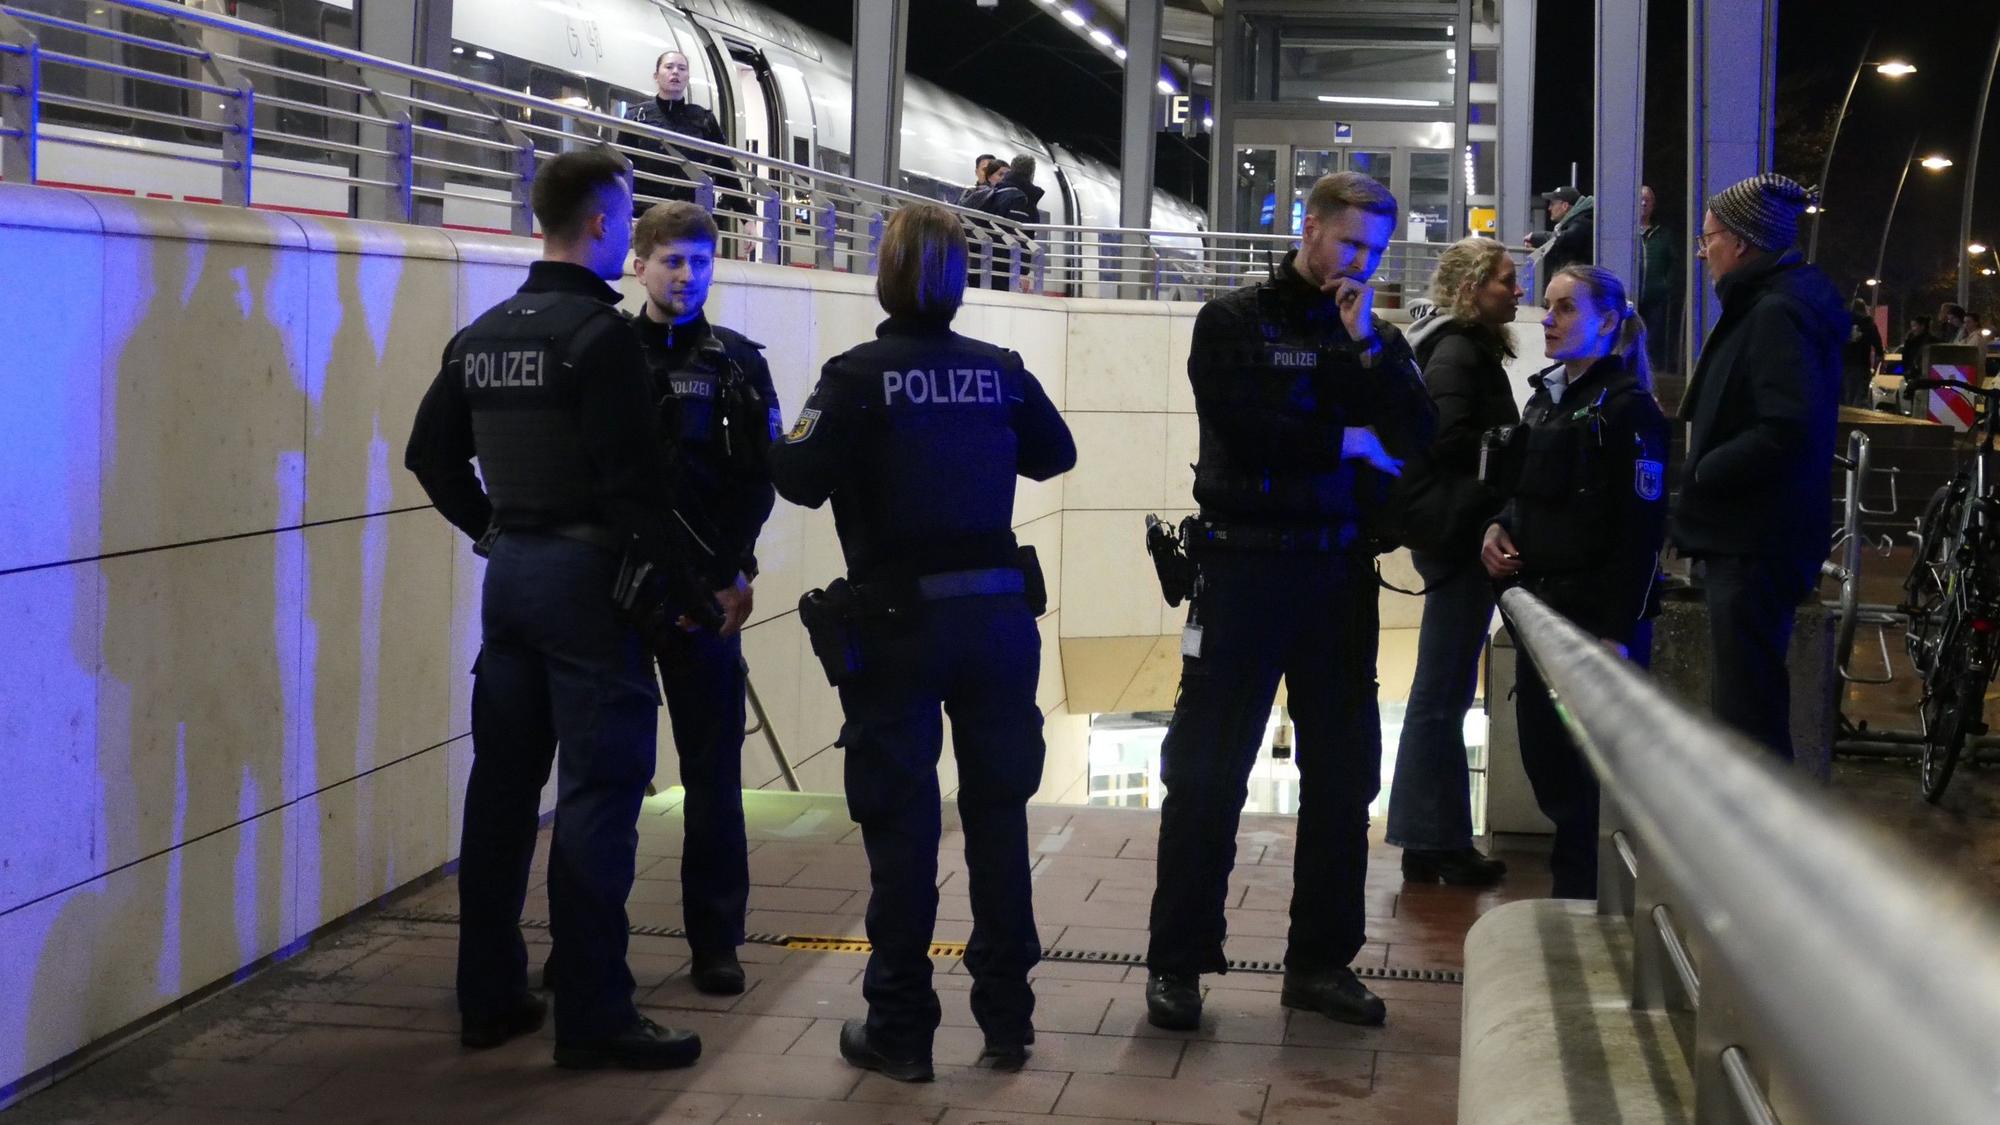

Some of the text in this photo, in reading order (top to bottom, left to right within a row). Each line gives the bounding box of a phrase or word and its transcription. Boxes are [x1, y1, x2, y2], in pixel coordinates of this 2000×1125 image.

[1172, 95, 1190, 124] E
[465, 351, 544, 388] POLIZEI
[1274, 352, 1318, 366] POLIZEI
[882, 368, 1002, 406] POLIZEI
